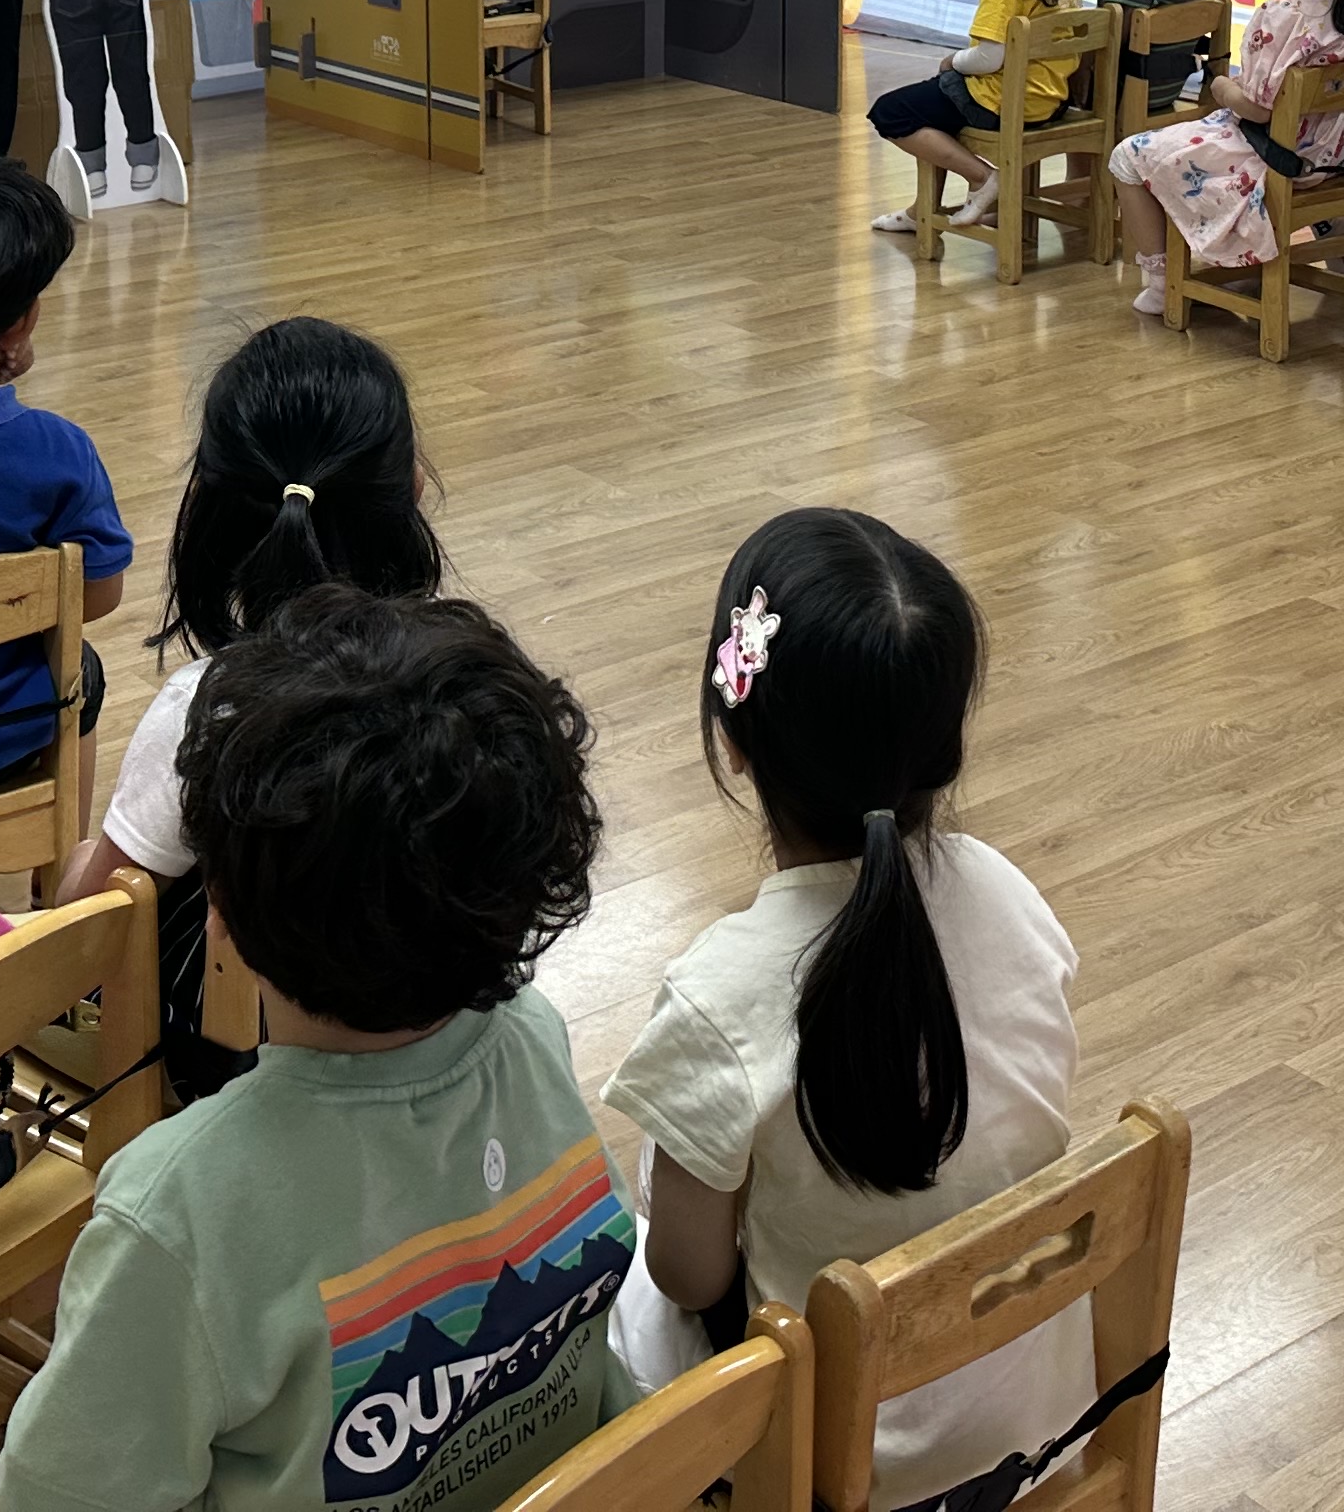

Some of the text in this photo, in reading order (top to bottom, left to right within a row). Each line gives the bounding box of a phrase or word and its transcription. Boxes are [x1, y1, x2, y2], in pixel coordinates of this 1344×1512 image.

[466, 1365, 571, 1449] CALIFORNIA
[516, 1418, 536, 1446] IN
[542, 1387, 578, 1428] 1973
